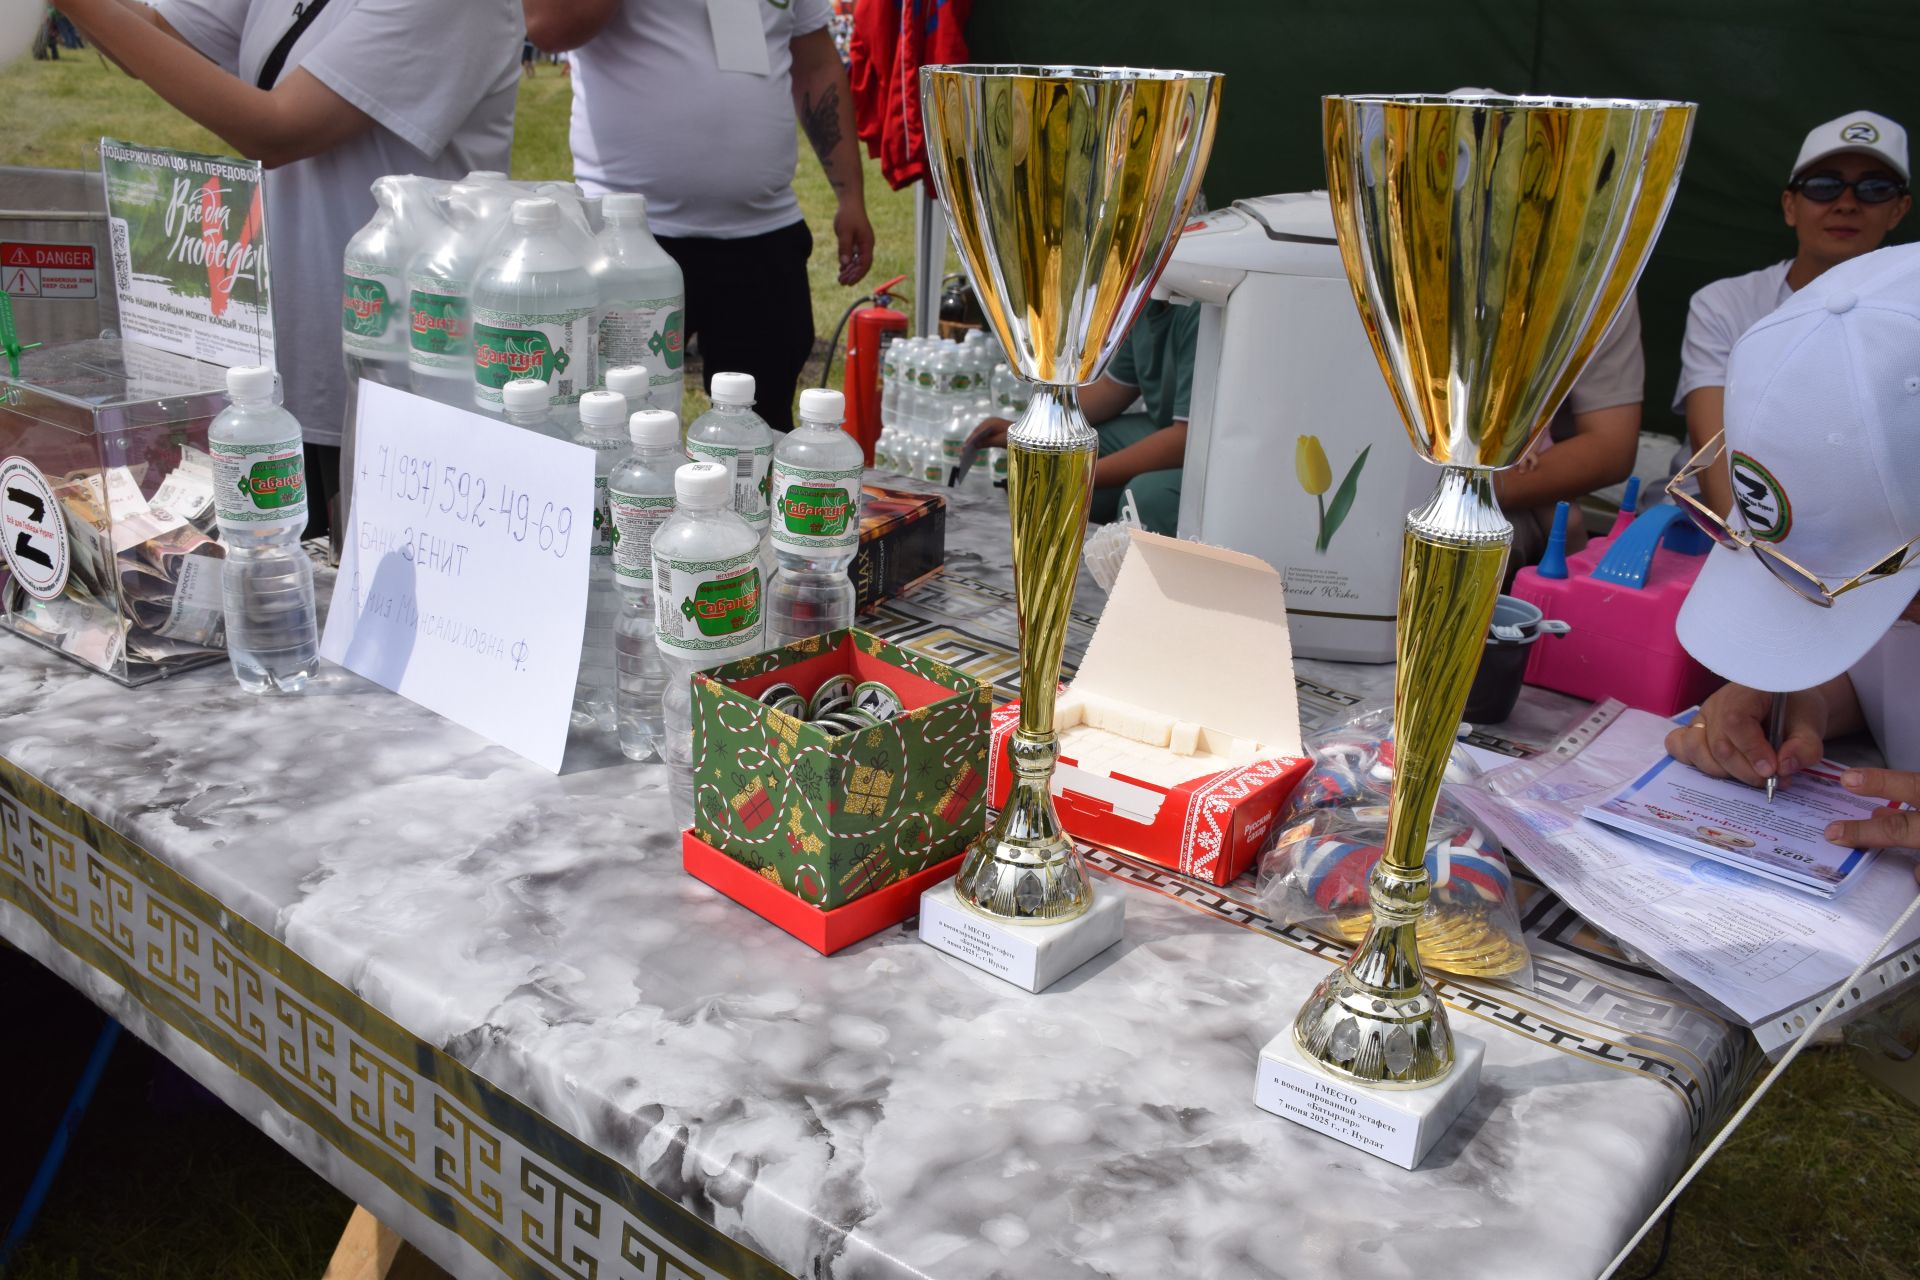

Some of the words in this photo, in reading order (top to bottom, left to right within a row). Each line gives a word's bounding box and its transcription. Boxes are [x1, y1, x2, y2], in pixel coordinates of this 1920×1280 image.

[103, 145, 151, 164] ПОДДЕРЖИ
[190, 161, 203, 174] НА
[204, 164, 260, 183] ПЕРЕДОВОЙ
[36, 250, 91, 266] DANGER
[136, 297, 158, 310] НАШИМ
[159, 303, 184, 317] БОЙЦАМ
[186, 310, 207, 322] МОЖЕТ
[209, 315, 237, 330] КАЖДЫЙ
[785, 499, 849, 521] Сабантуй
[360, 521, 397, 555] БАНК
[401, 527, 469, 577] ЗЕНИТ
[1320, 585, 1360, 600] Wishes
[511, 637, 529, 673] Ф.
[1244, 809, 1272, 836] Русский
[1773, 847, 1815, 865] 2025
[967, 924, 991, 940] МЕСТО
[962, 944, 975, 956] 2025
[988, 958, 1009, 972] Нурлат
[1280, 1080, 1356, 1116] военизированной
[1357, 1112, 1397, 1134] эстафете
[1320, 1086, 1358, 1106] МЕСТО
[1278, 1098, 1284, 1106] 7
[1284, 1102, 1308, 1117] июня
[1309, 1110, 1329, 1126] 2025
[1351, 1129, 1385, 1151] Нурлат
[1306, 1102, 1360, 1128] «Батырлар»
